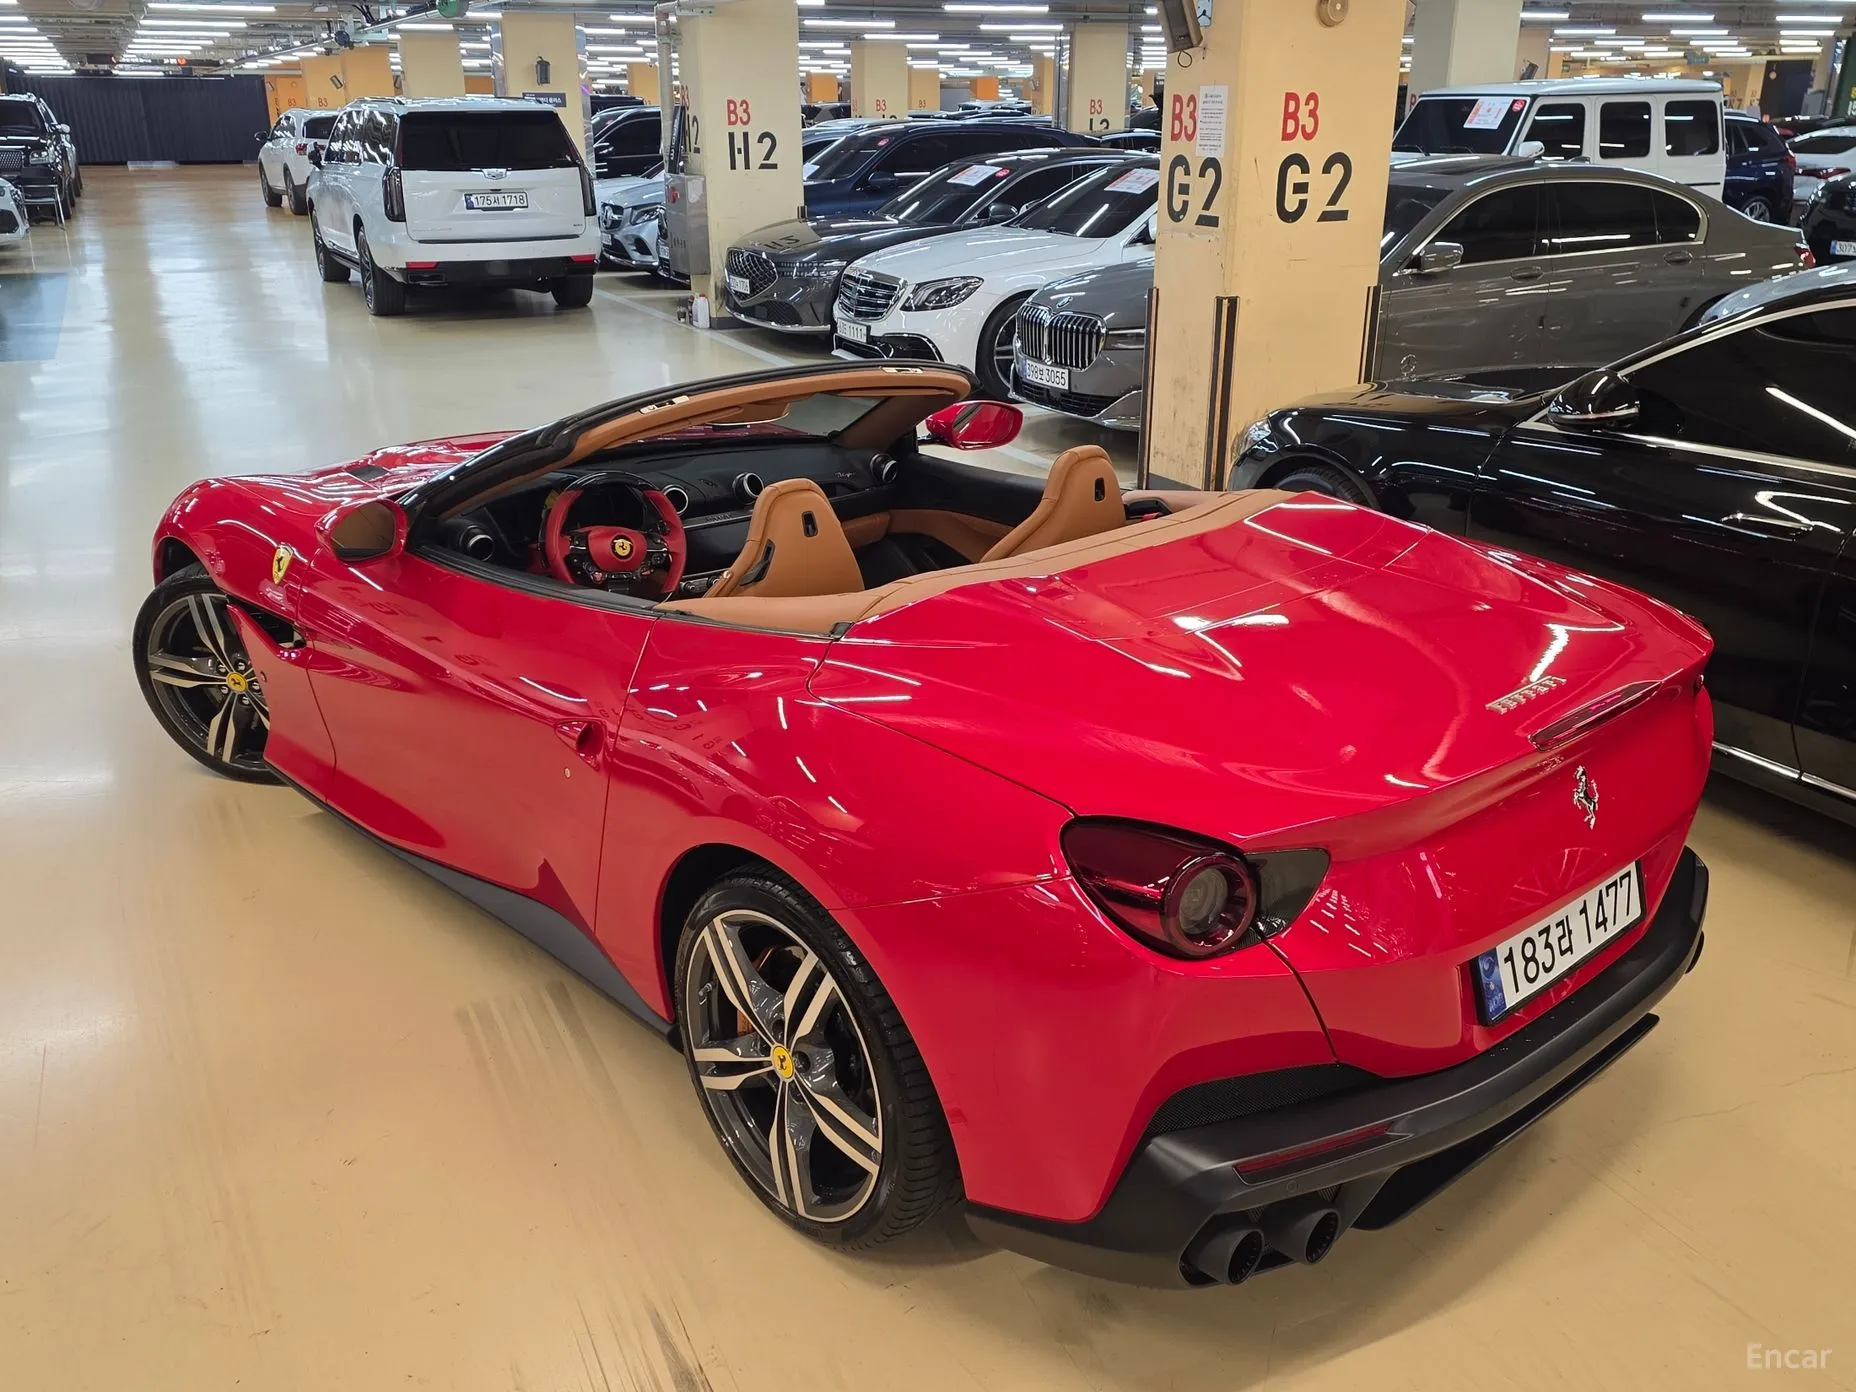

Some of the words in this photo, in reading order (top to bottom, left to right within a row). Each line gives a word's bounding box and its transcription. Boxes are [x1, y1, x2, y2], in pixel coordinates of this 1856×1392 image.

[726, 98, 751, 126] B3
[875, 99, 887, 112] B3
[1089, 99, 1103, 115] B3
[1170, 93, 1197, 143] B3
[1281, 91, 1320, 142] B3
[727, 131, 778, 171] H2
[502, 194, 525, 205] 1718
[1166, 154, 1222, 228] G2
[1275, 152, 1352, 224] G2
[1045, 368, 1067, 386] 3055
[1485, 675, 1566, 715] Ferrari
[1504, 915, 1573, 993] 183라
[1579, 870, 1632, 944] 1477
